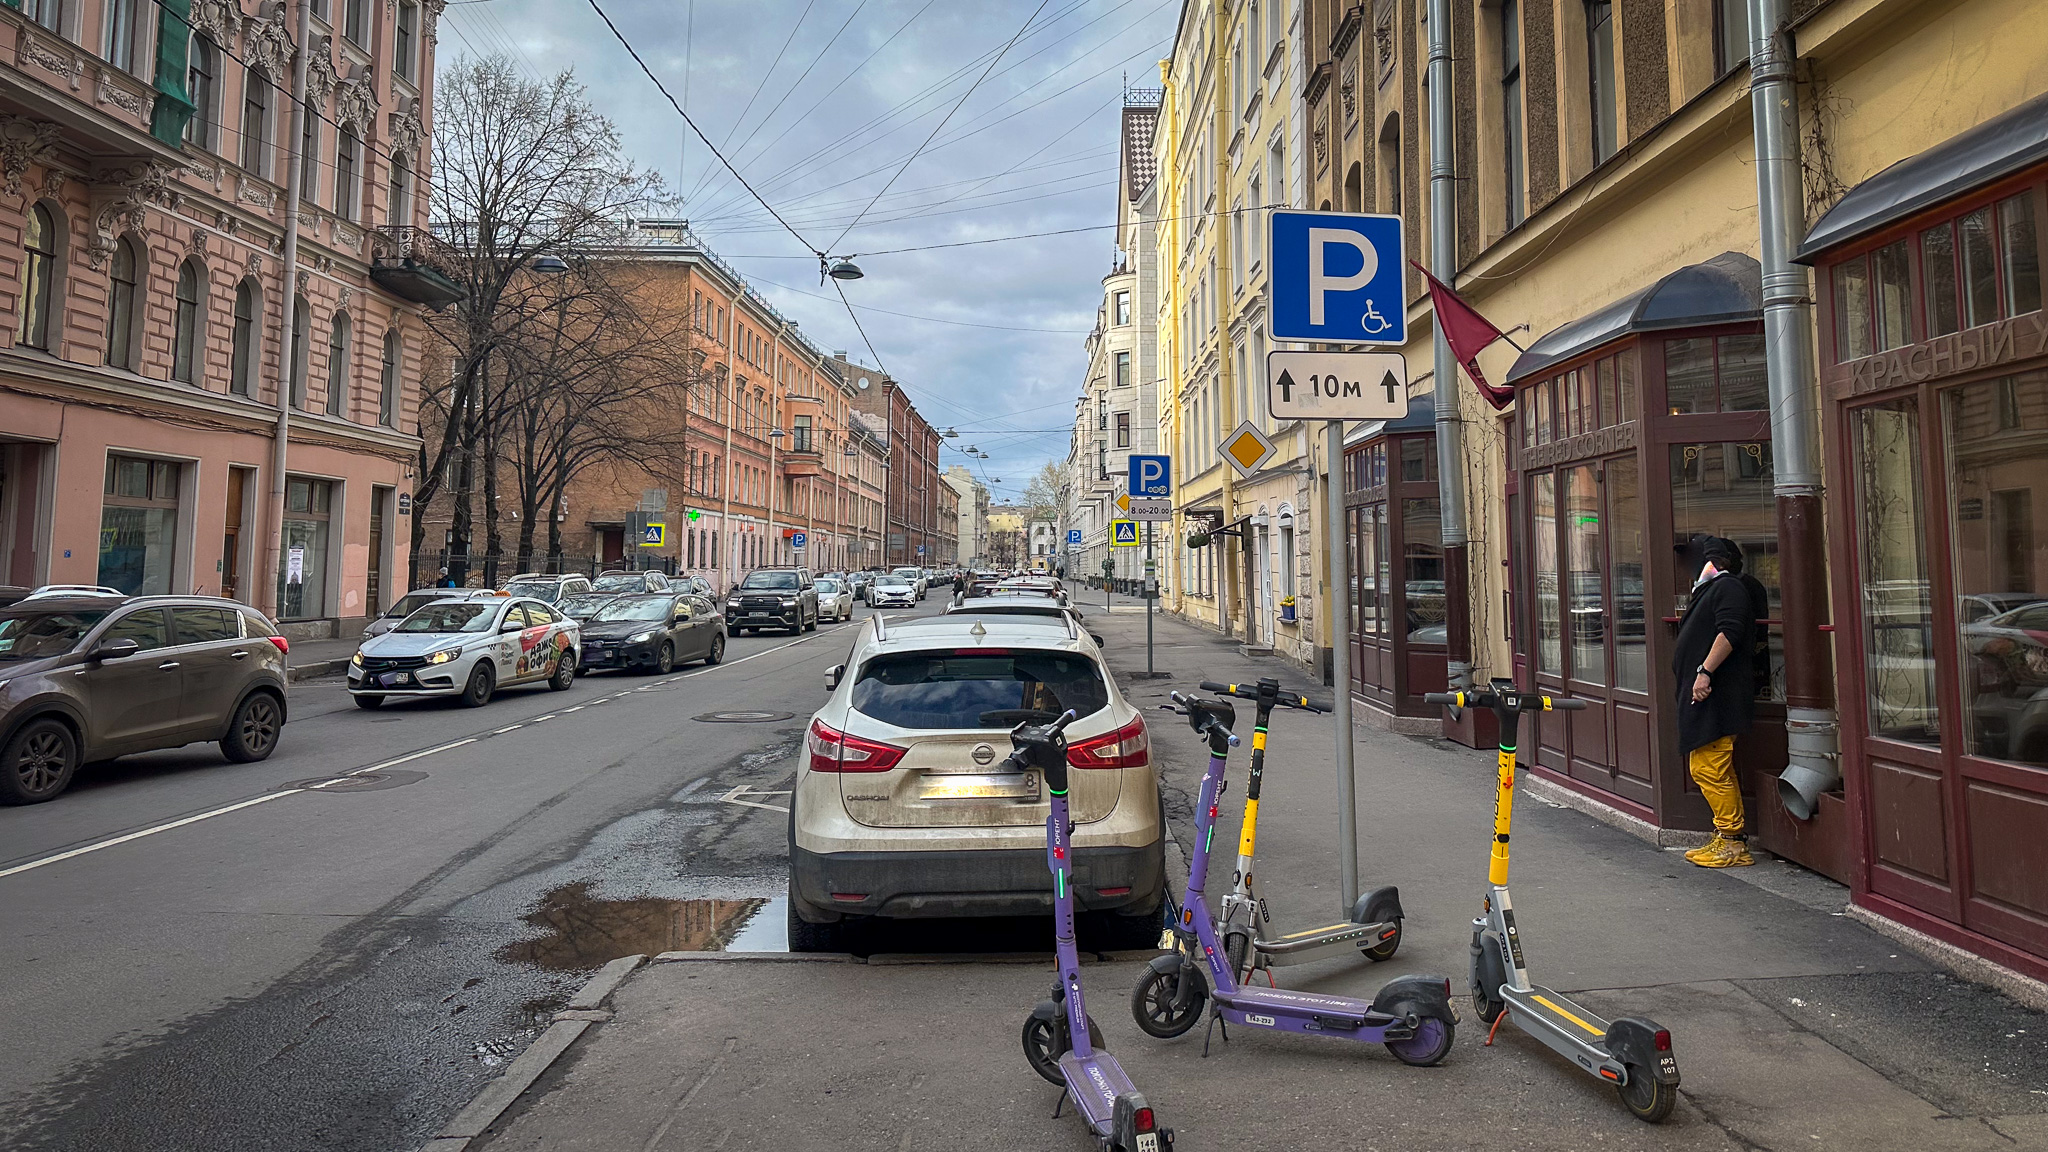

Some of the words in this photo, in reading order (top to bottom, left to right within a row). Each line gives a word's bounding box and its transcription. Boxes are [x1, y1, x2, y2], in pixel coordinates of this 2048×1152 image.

[1309, 227, 1378, 325] P
[1850, 319, 2017, 395] КРАСНЫЙ
[1523, 449, 1544, 470] THE
[1547, 440, 1573, 464] RED
[1576, 425, 1635, 458] CORNER
[1140, 460, 1163, 492] P
[1071, 531, 1080, 541] P
[1660, 1057, 1674, 1065] AP2
[1663, 1066, 1676, 1074] 107
[1140, 1139, 1155, 1149] 148
